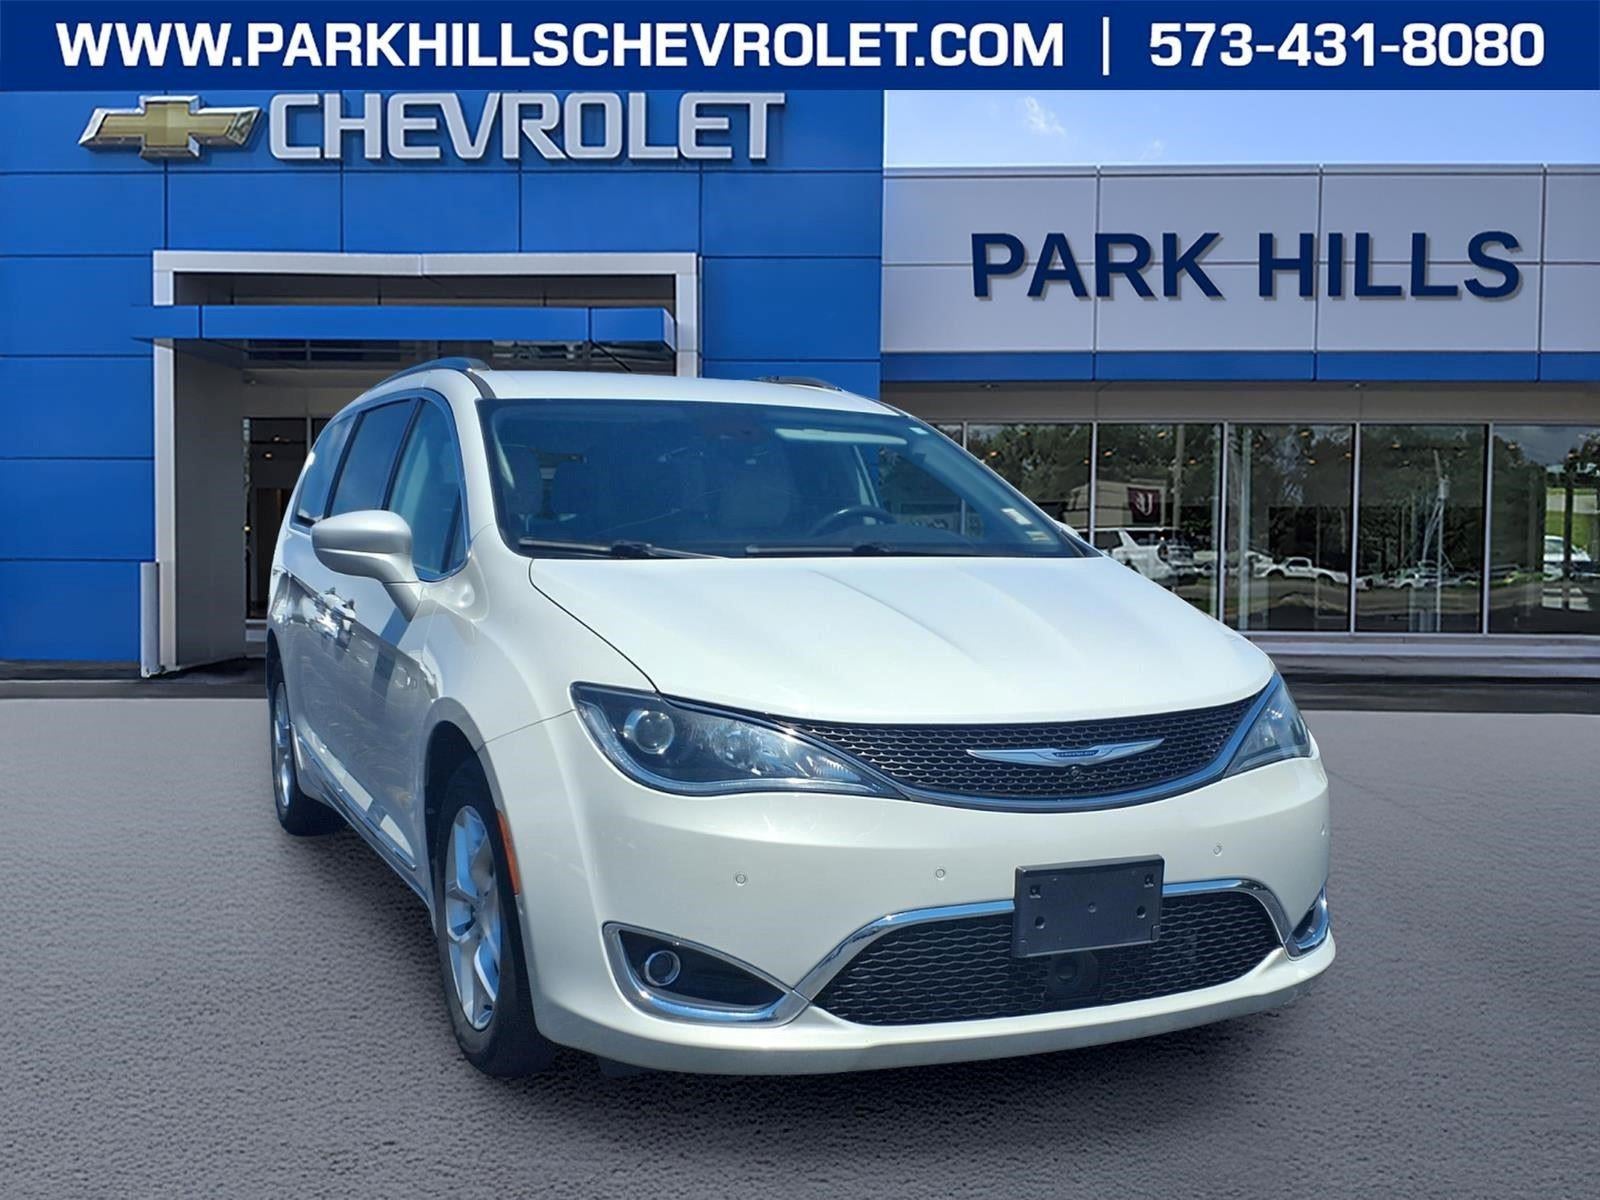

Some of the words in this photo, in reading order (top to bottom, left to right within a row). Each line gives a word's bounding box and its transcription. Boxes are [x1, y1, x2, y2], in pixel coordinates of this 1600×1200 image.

[269, 92, 785, 161] CHEVROLET
[971, 232, 1222, 299] PARK
[1258, 231, 1523, 300] HILLS
